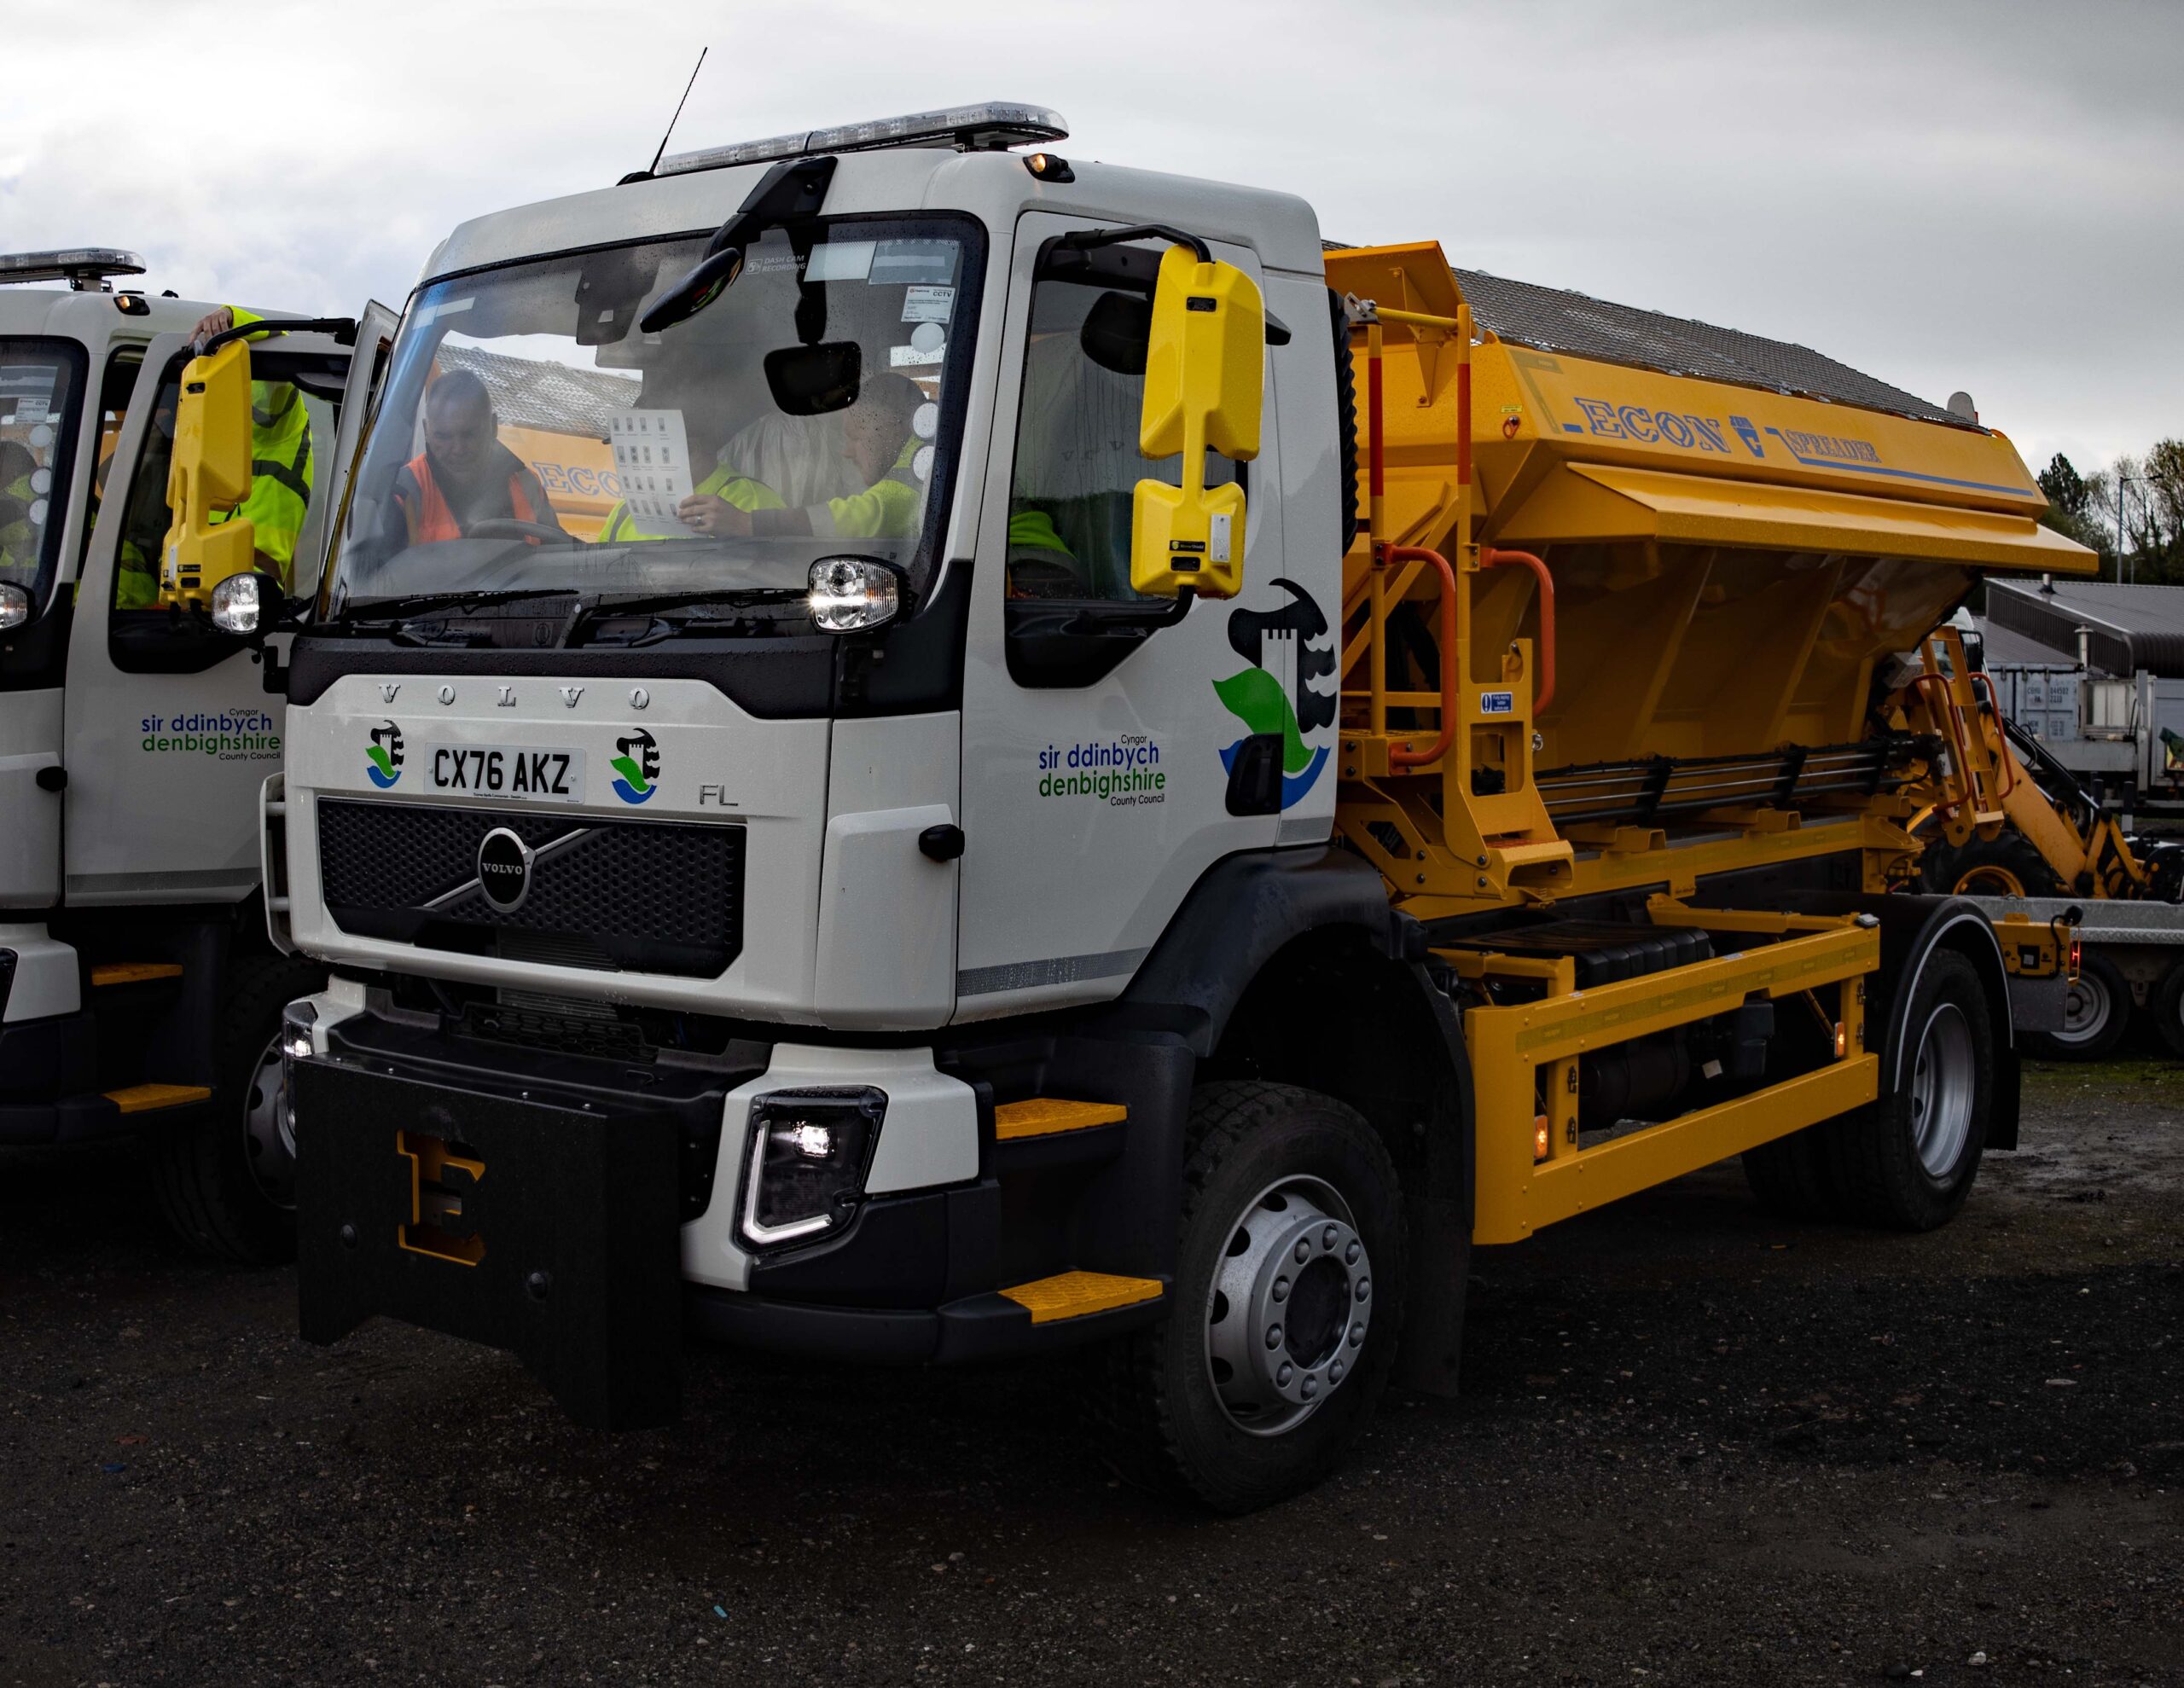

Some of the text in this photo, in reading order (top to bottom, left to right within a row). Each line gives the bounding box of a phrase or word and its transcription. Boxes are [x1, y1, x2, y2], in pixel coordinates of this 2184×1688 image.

[762, 262, 806, 272] RECORDING
[764, 254, 804, 264] DASH CAM
[1574, 397, 1881, 464] ECON SPREADER
[379, 683, 650, 711] VOLVO
[229, 708, 258, 716] Cyngor
[142, 714, 272, 735] sir ddinbych
[142, 733, 281, 755] denbighshire
[1120, 734, 1147, 746] Cyngor
[219, 751, 281, 761] County Council
[1039, 740, 1159, 771] sir ddinbych
[434, 749, 571, 794] CX76 AKZ
[1039, 767, 1165, 799] denbighshire
[700, 784, 739, 806] FL
[1110, 793, 1165, 807] County Council
[482, 862, 523, 875] VOLVO
